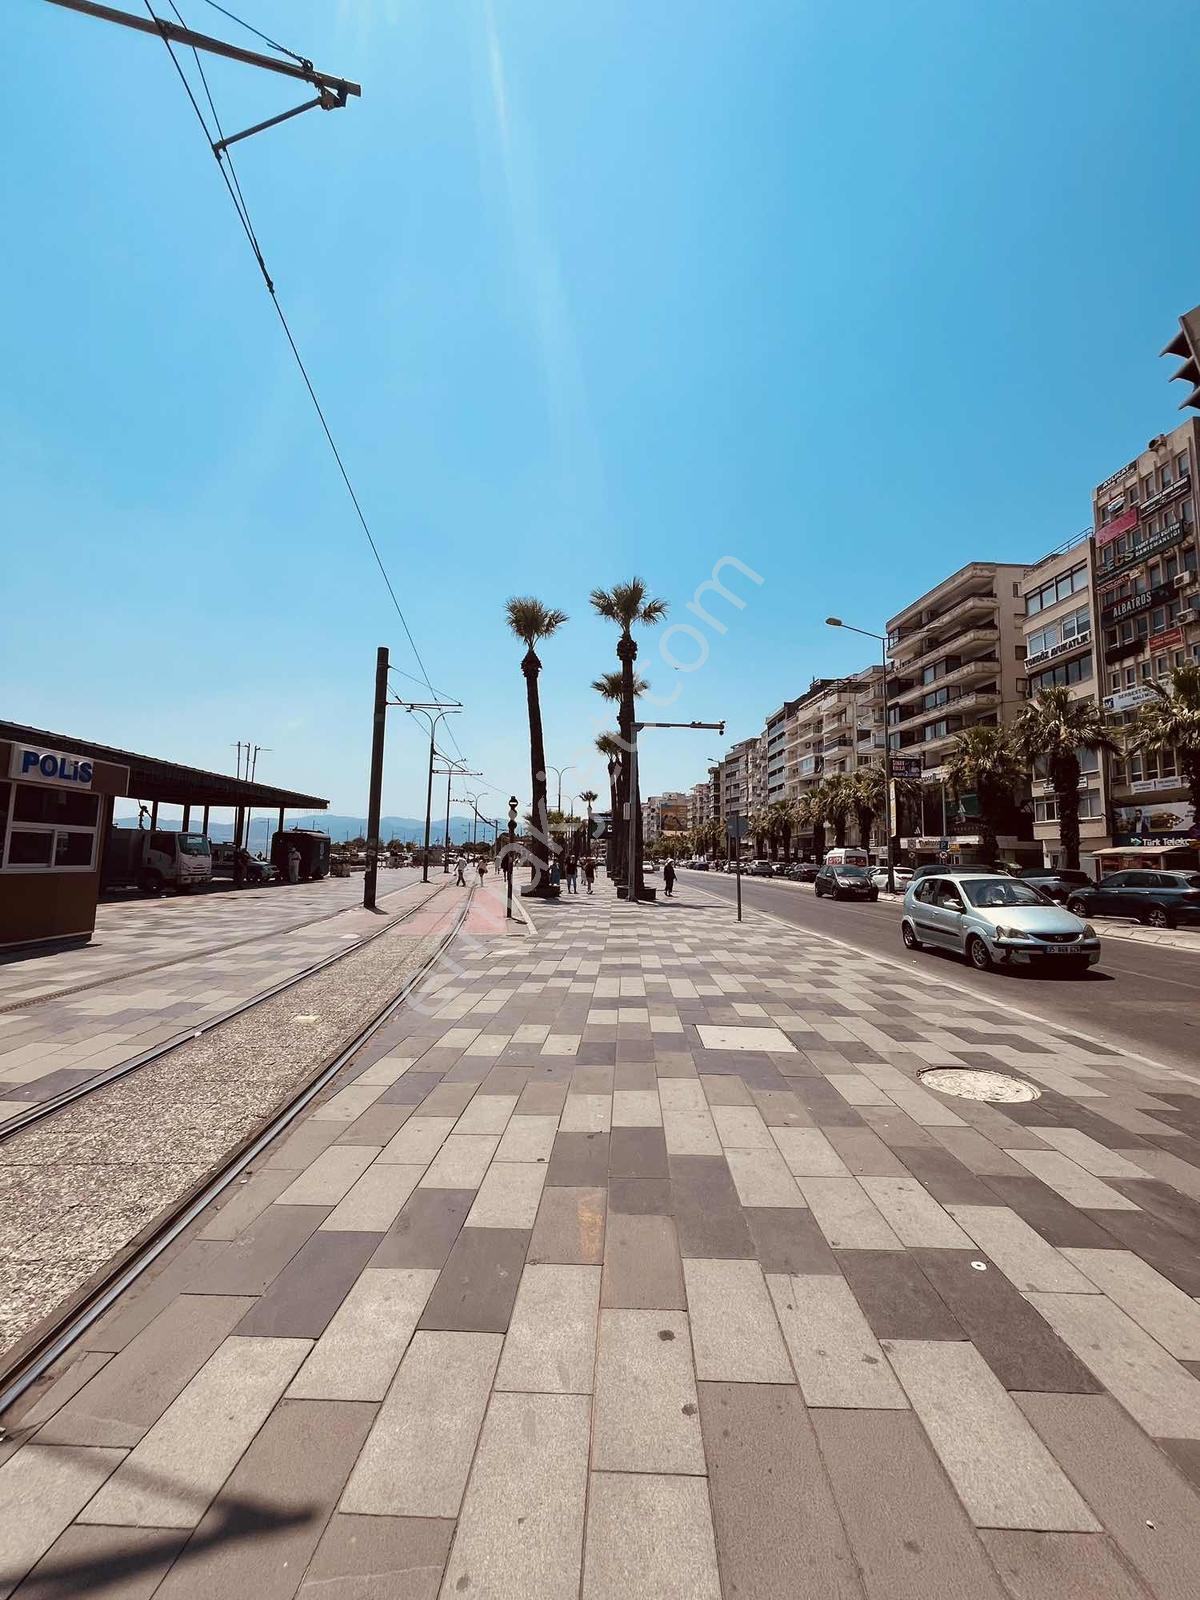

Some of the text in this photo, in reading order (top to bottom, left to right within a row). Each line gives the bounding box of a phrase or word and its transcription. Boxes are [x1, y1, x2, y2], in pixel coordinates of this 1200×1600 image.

[1106, 547, 1134, 572] ECS
[1112, 591, 1152, 618] ALBATROS
[1051, 633, 1089, 657] AVUKATLIK
[1142, 837, 1161, 846] Türk
